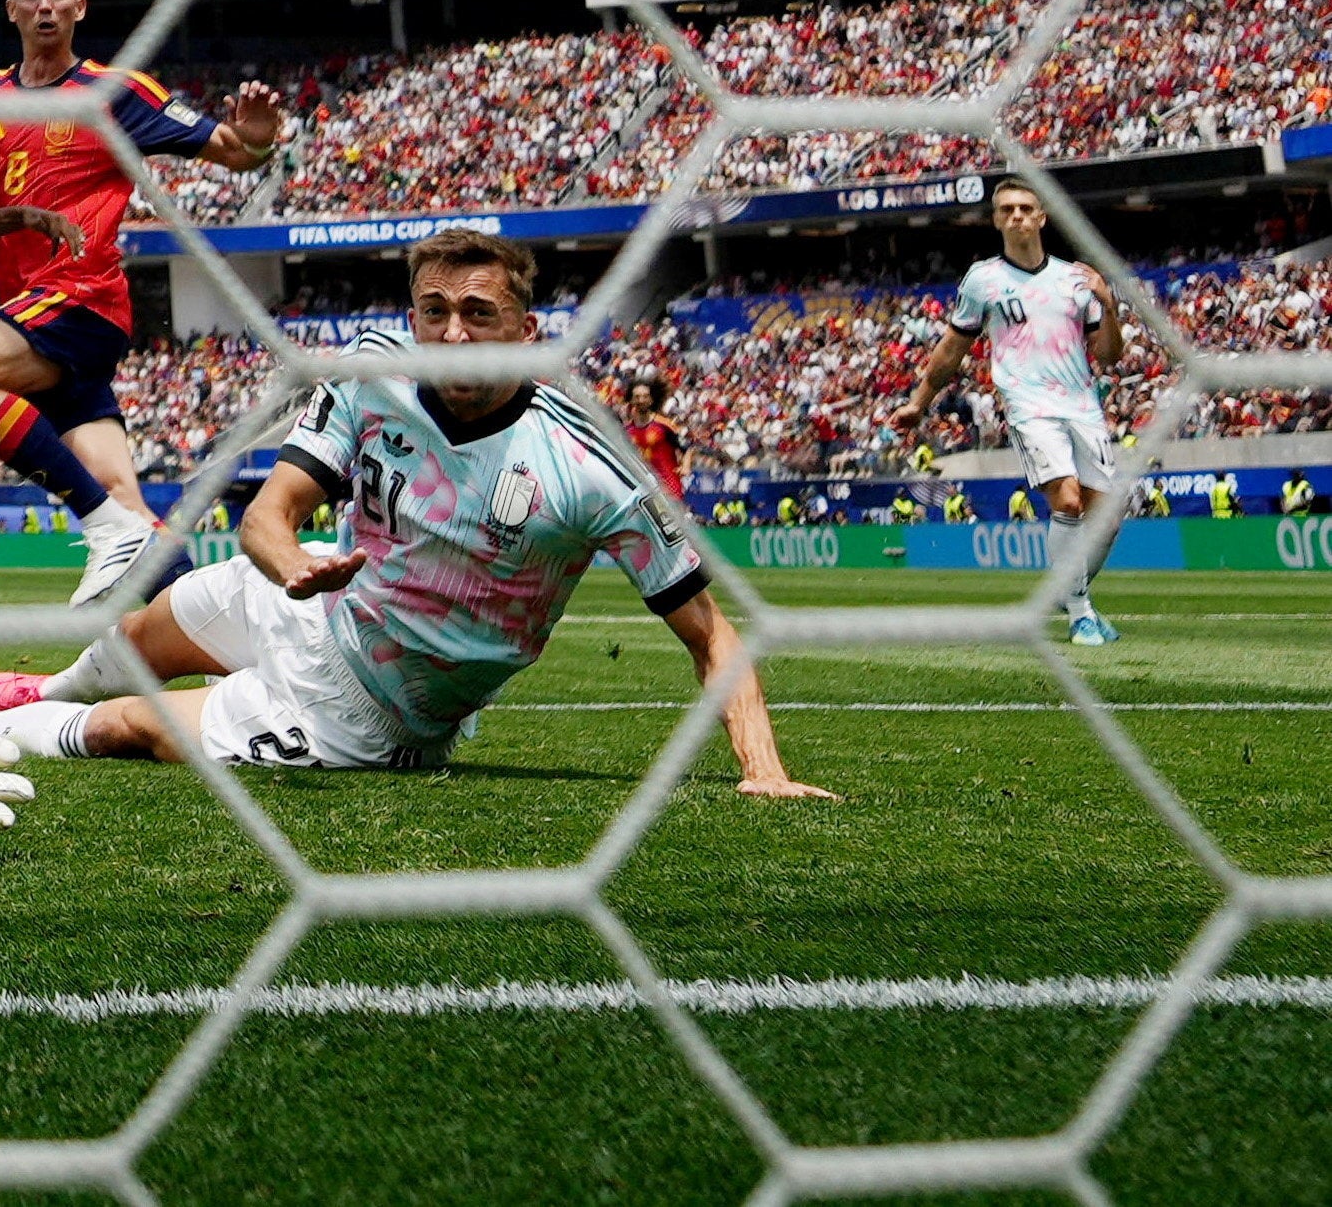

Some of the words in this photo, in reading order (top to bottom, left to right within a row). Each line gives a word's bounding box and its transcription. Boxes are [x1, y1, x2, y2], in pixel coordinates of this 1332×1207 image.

[4, 150, 29, 196] 8
[838, 188, 879, 211] LOS
[289, 226, 329, 245] FIFA
[328, 222, 394, 244] WORLD
[395, 219, 434, 239] CUP
[996, 297, 1027, 326] 10
[361, 452, 406, 535] 21
[750, 527, 840, 567] aramco
[972, 523, 1052, 568] aram
